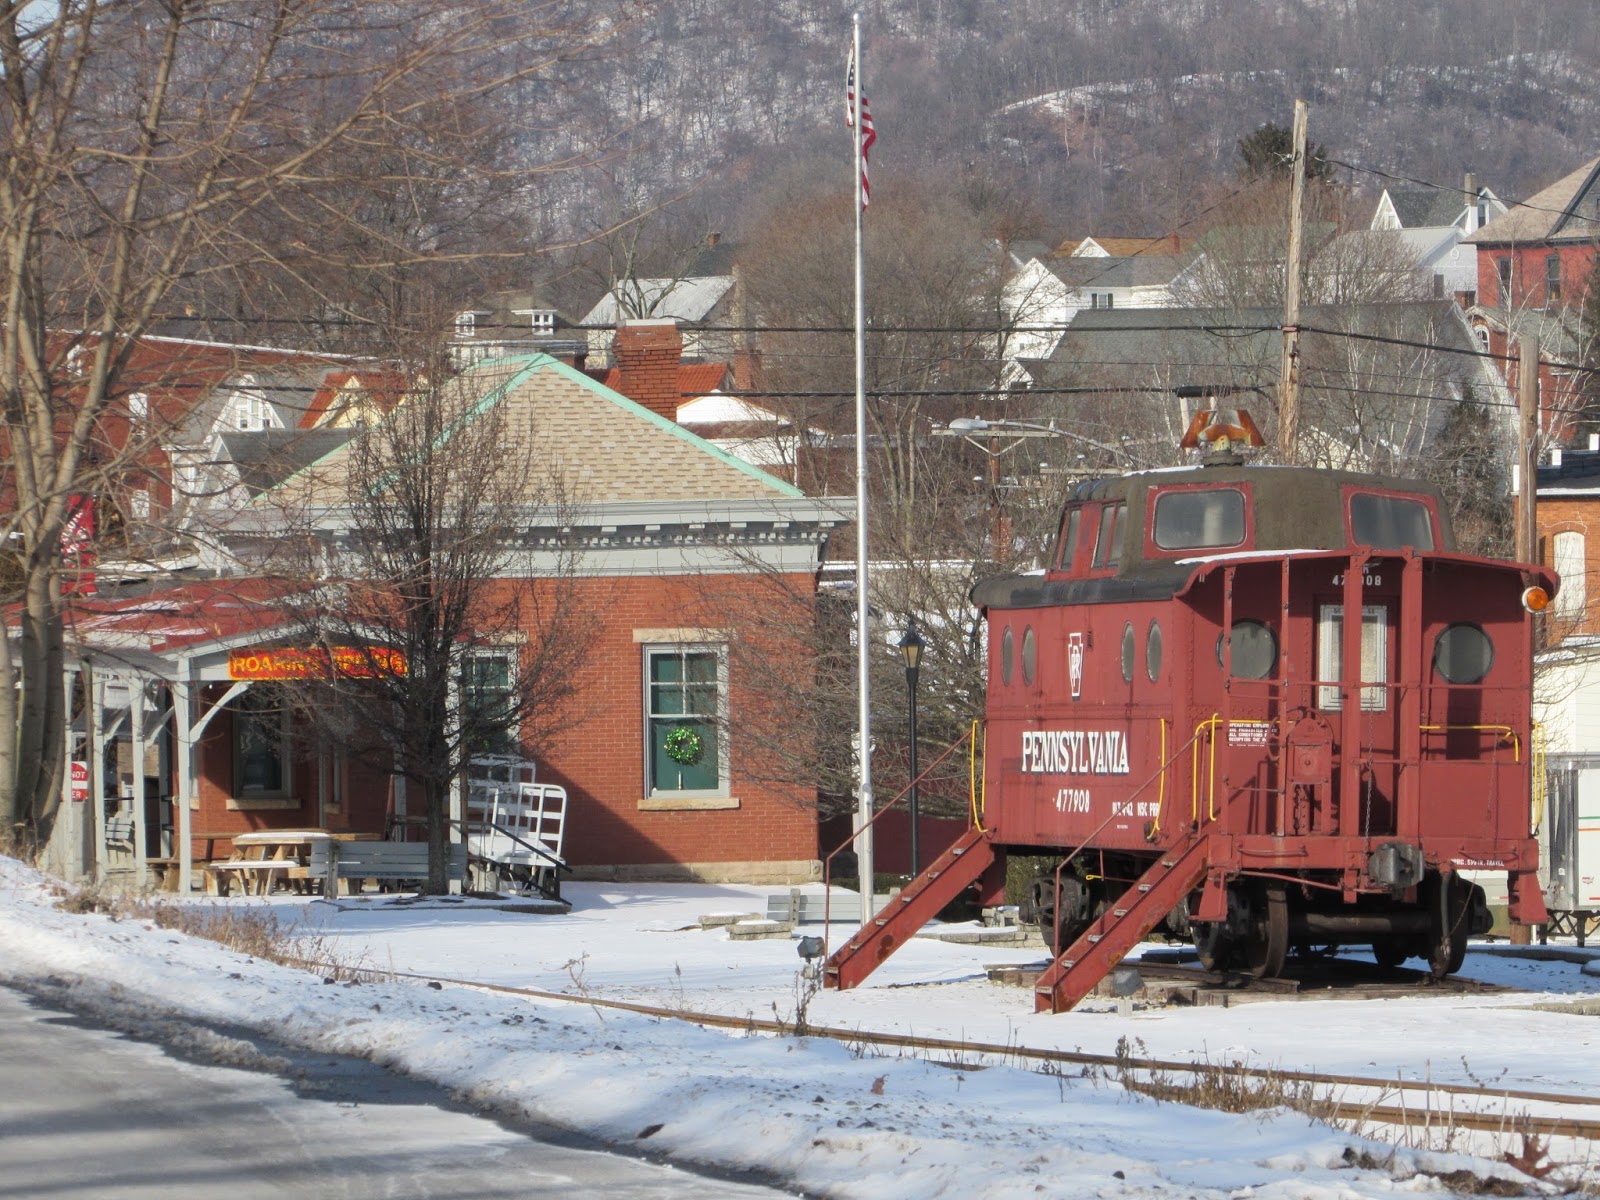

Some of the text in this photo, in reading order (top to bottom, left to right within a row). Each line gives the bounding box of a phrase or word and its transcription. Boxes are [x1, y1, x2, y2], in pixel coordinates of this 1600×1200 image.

[1332, 575, 1381, 586] 4708
[1022, 731, 1129, 773] PENNSYLVANIA
[1056, 789, 1090, 813] 477908
